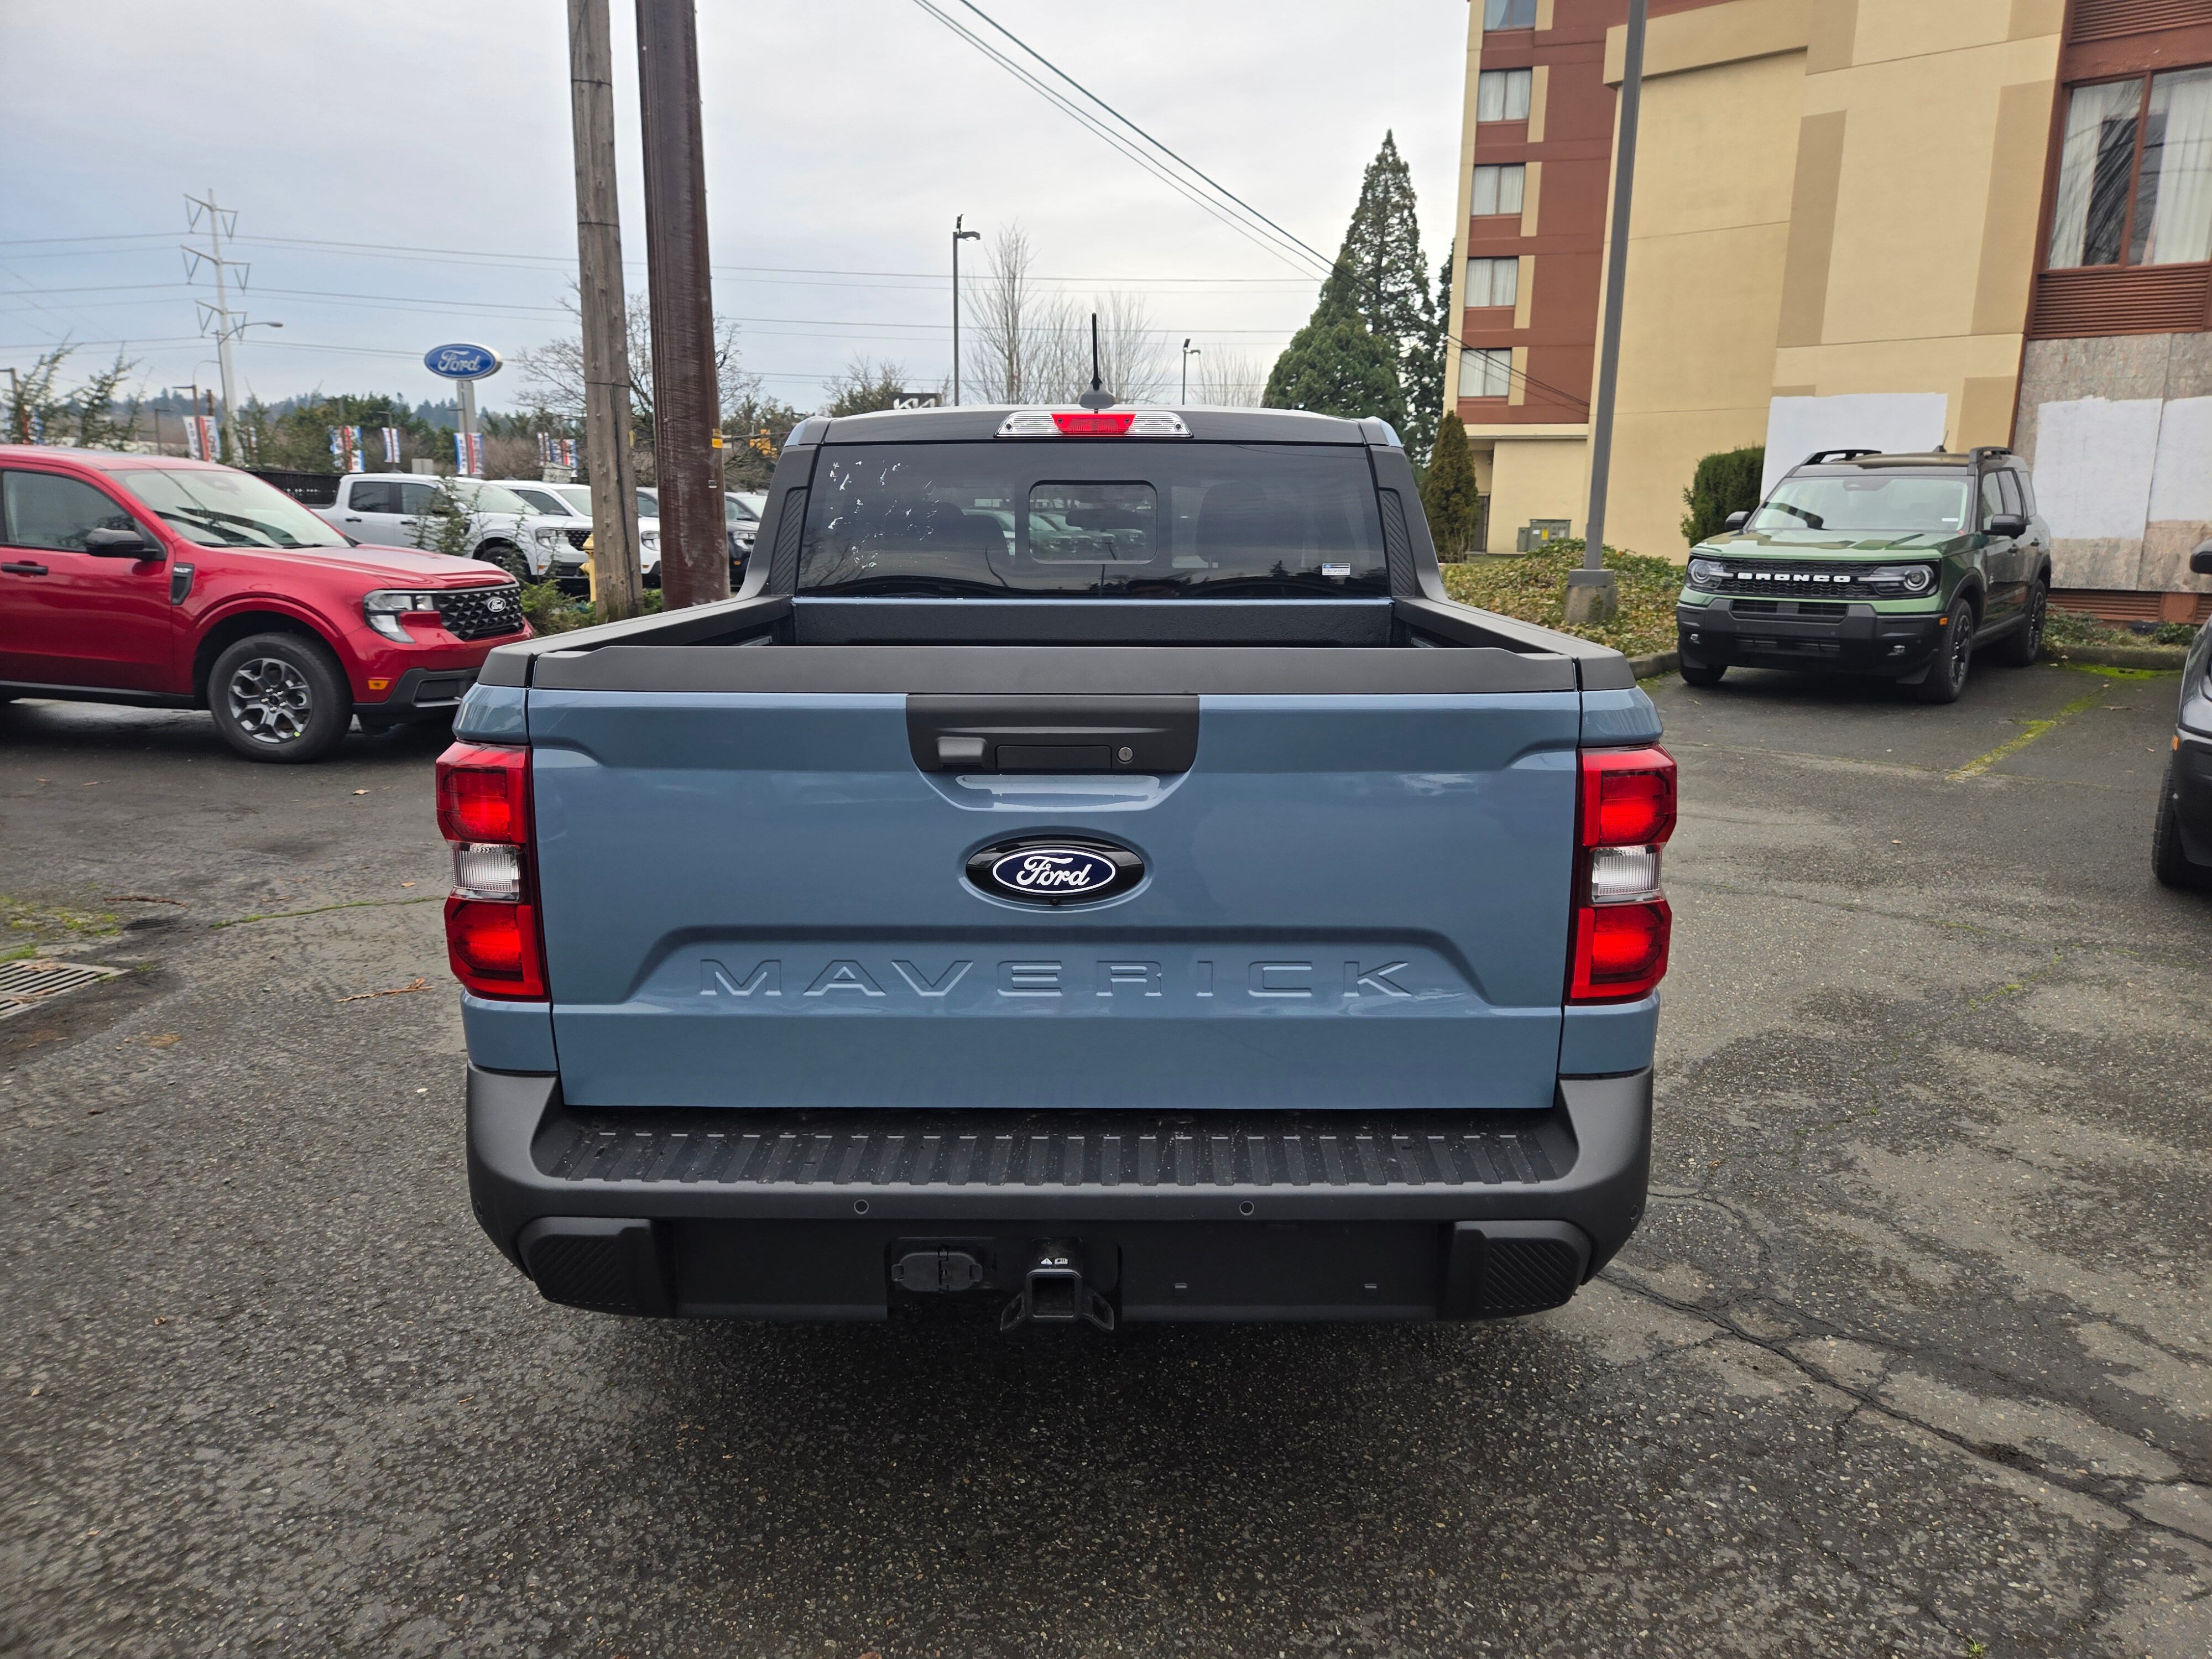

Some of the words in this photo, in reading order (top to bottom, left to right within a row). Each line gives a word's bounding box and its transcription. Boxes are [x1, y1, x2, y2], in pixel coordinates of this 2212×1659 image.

[437, 349, 481, 372] Ford
[1738, 572, 1850, 582] BRONCO
[1016, 856, 1093, 885] Ford
[700, 959, 1412, 997] MAVERICK
